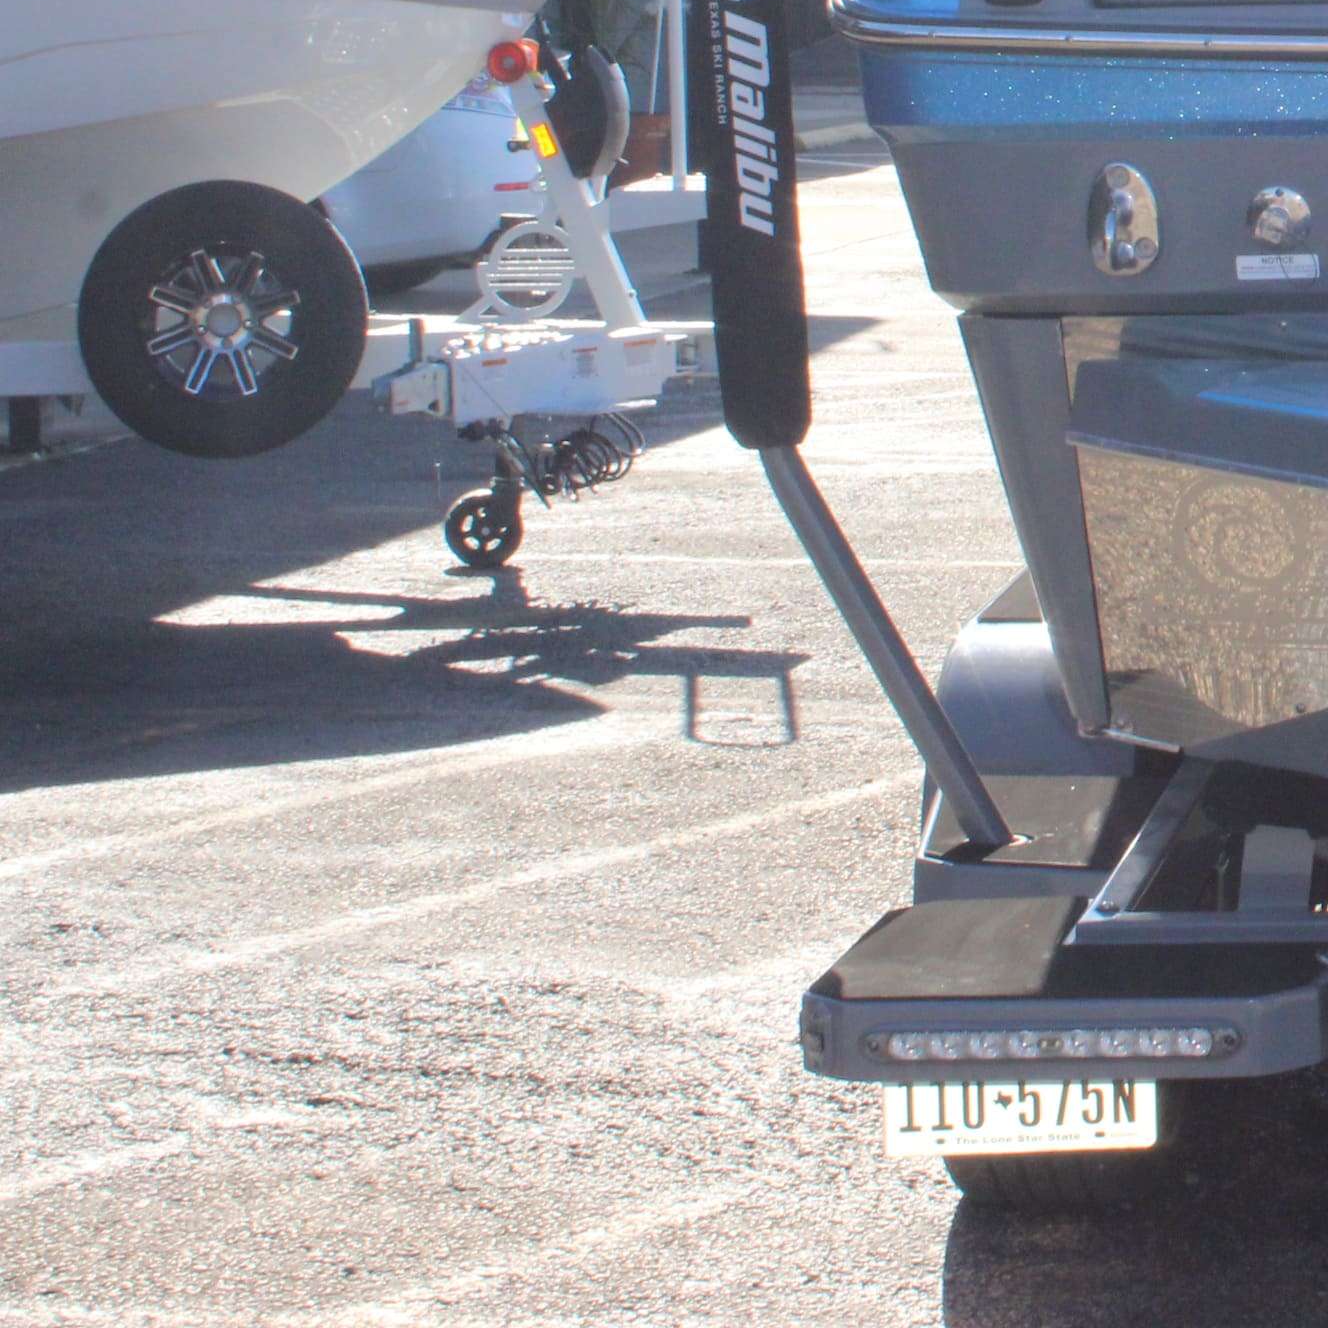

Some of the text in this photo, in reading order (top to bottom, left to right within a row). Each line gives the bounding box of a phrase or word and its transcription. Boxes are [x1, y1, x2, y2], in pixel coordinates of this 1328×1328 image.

[713, 44, 724, 70] SKI
[713, 72, 728, 126] RANCH
[1259, 255, 1296, 265] NOTICE
[956, 1133, 1081, 1145] The Lone Star State
